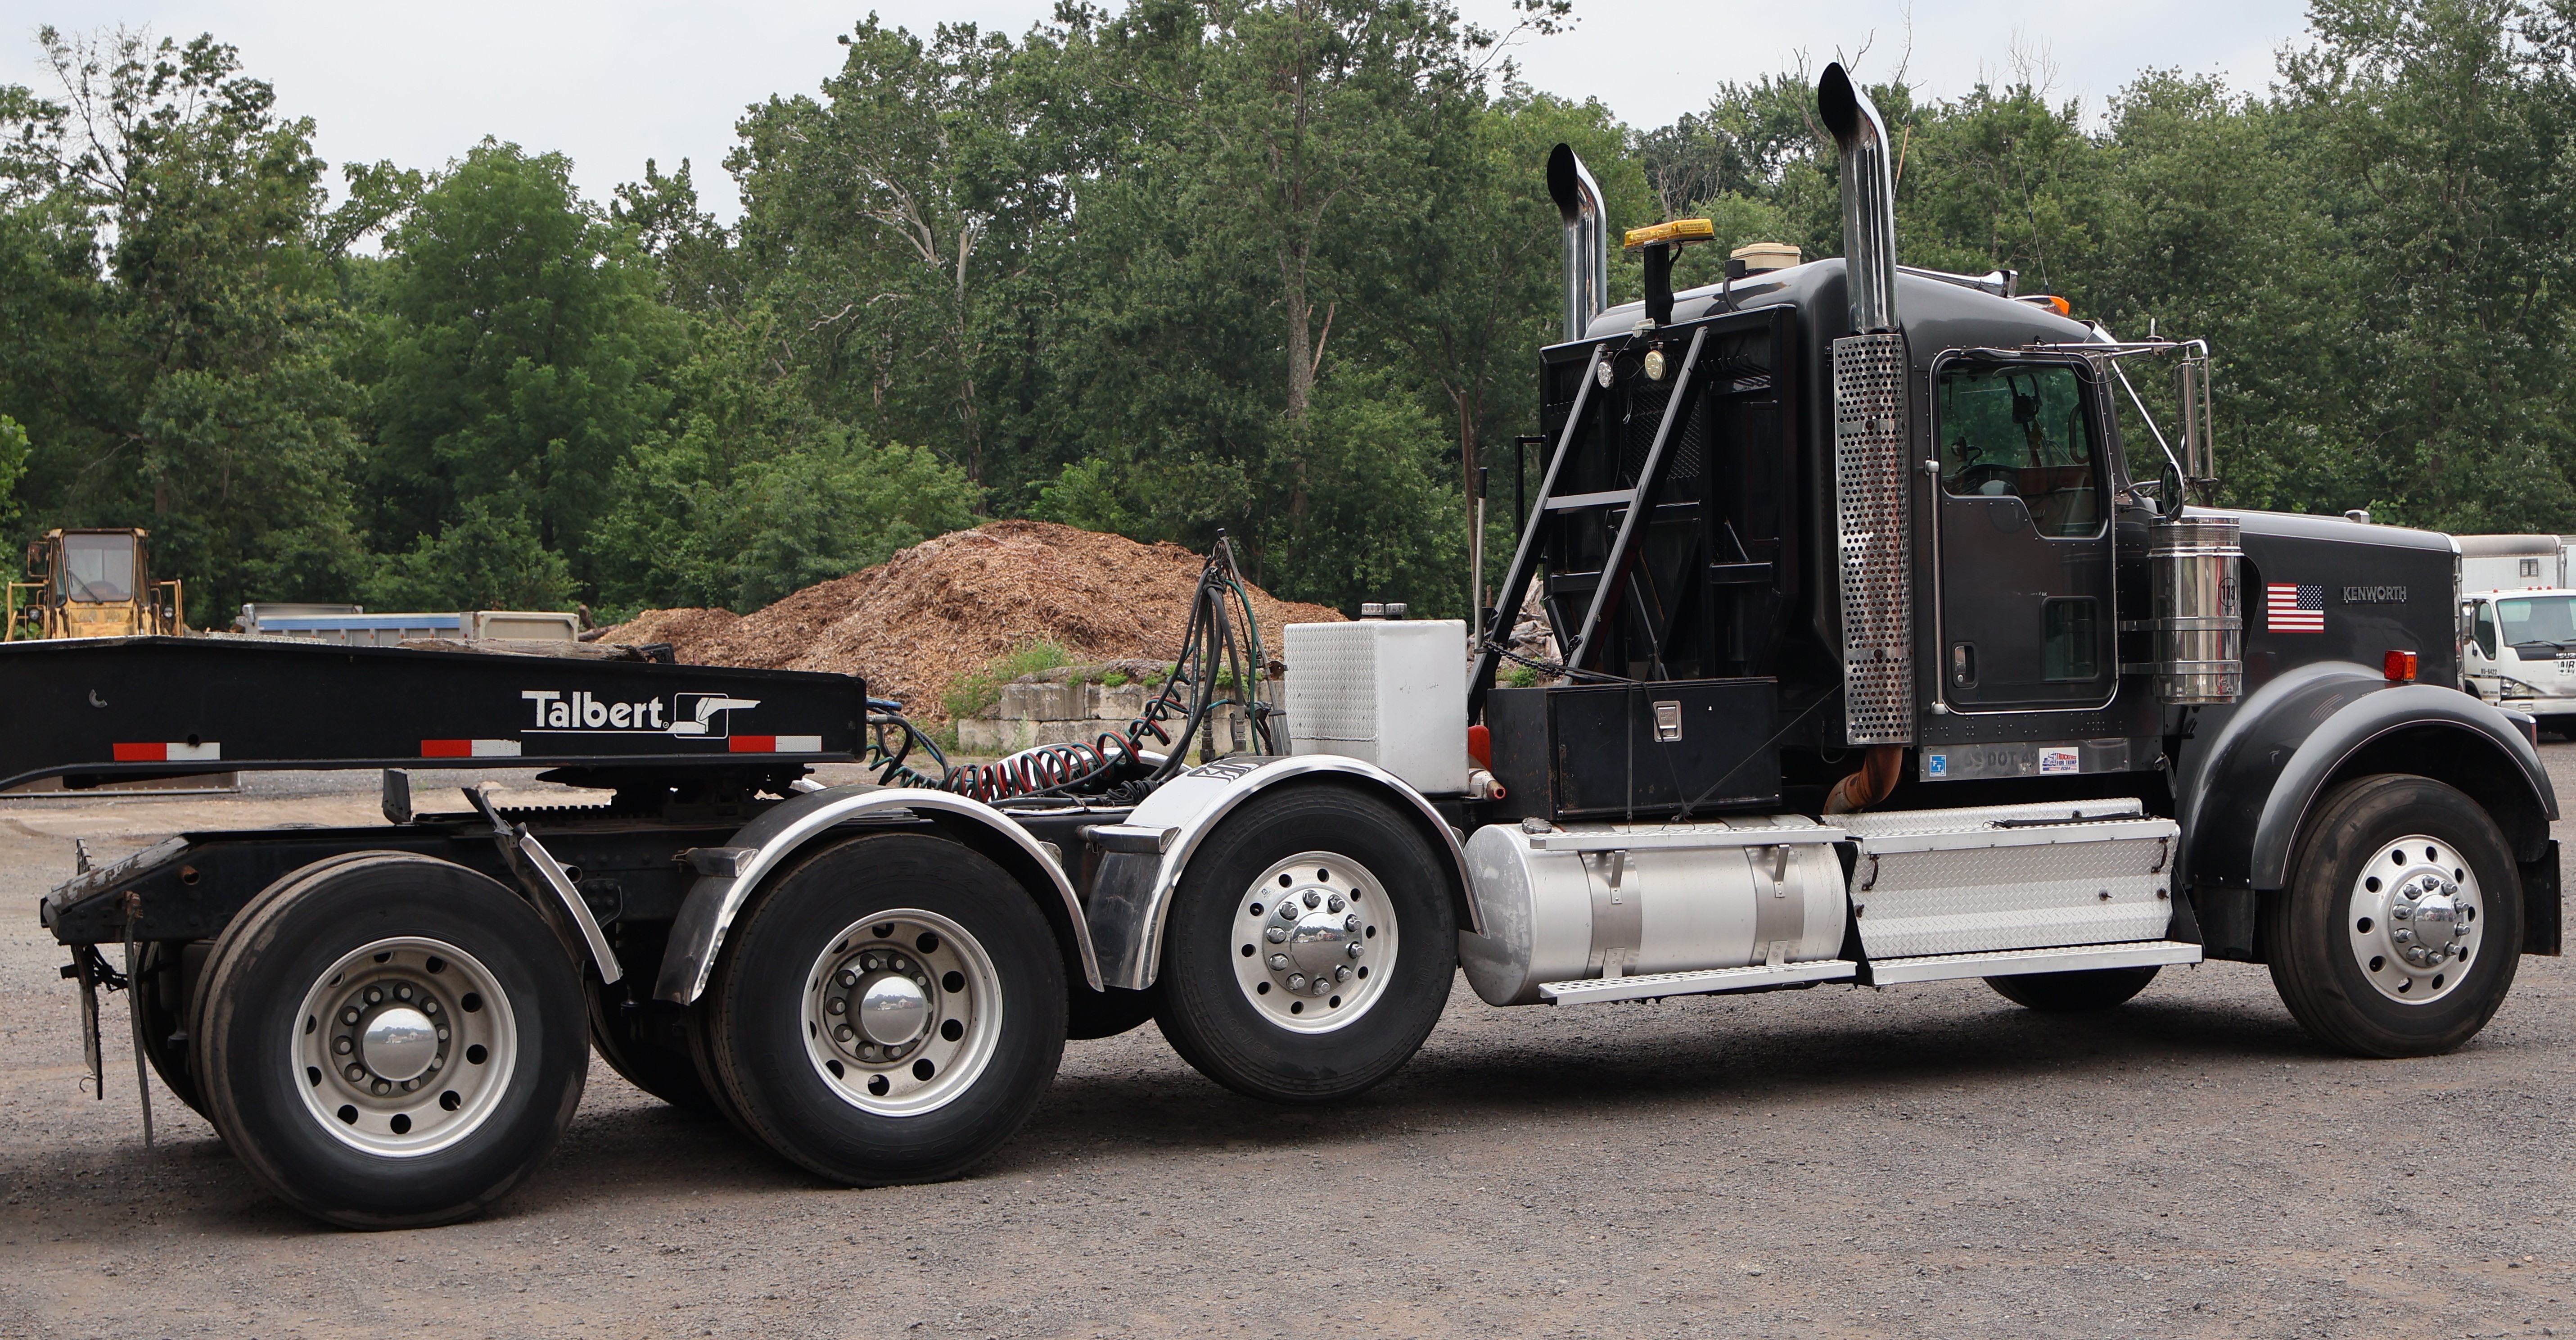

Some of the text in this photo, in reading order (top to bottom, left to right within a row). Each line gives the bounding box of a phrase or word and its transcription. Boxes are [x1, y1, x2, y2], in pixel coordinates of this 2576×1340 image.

[2222, 585, 2235, 600] 113
[2343, 586, 2406, 600] KENWORTH
[522, 690, 663, 728] Talbert
[1987, 751, 2017, 766] DOT
[1259, 816, 1379, 849] MICHELIN
